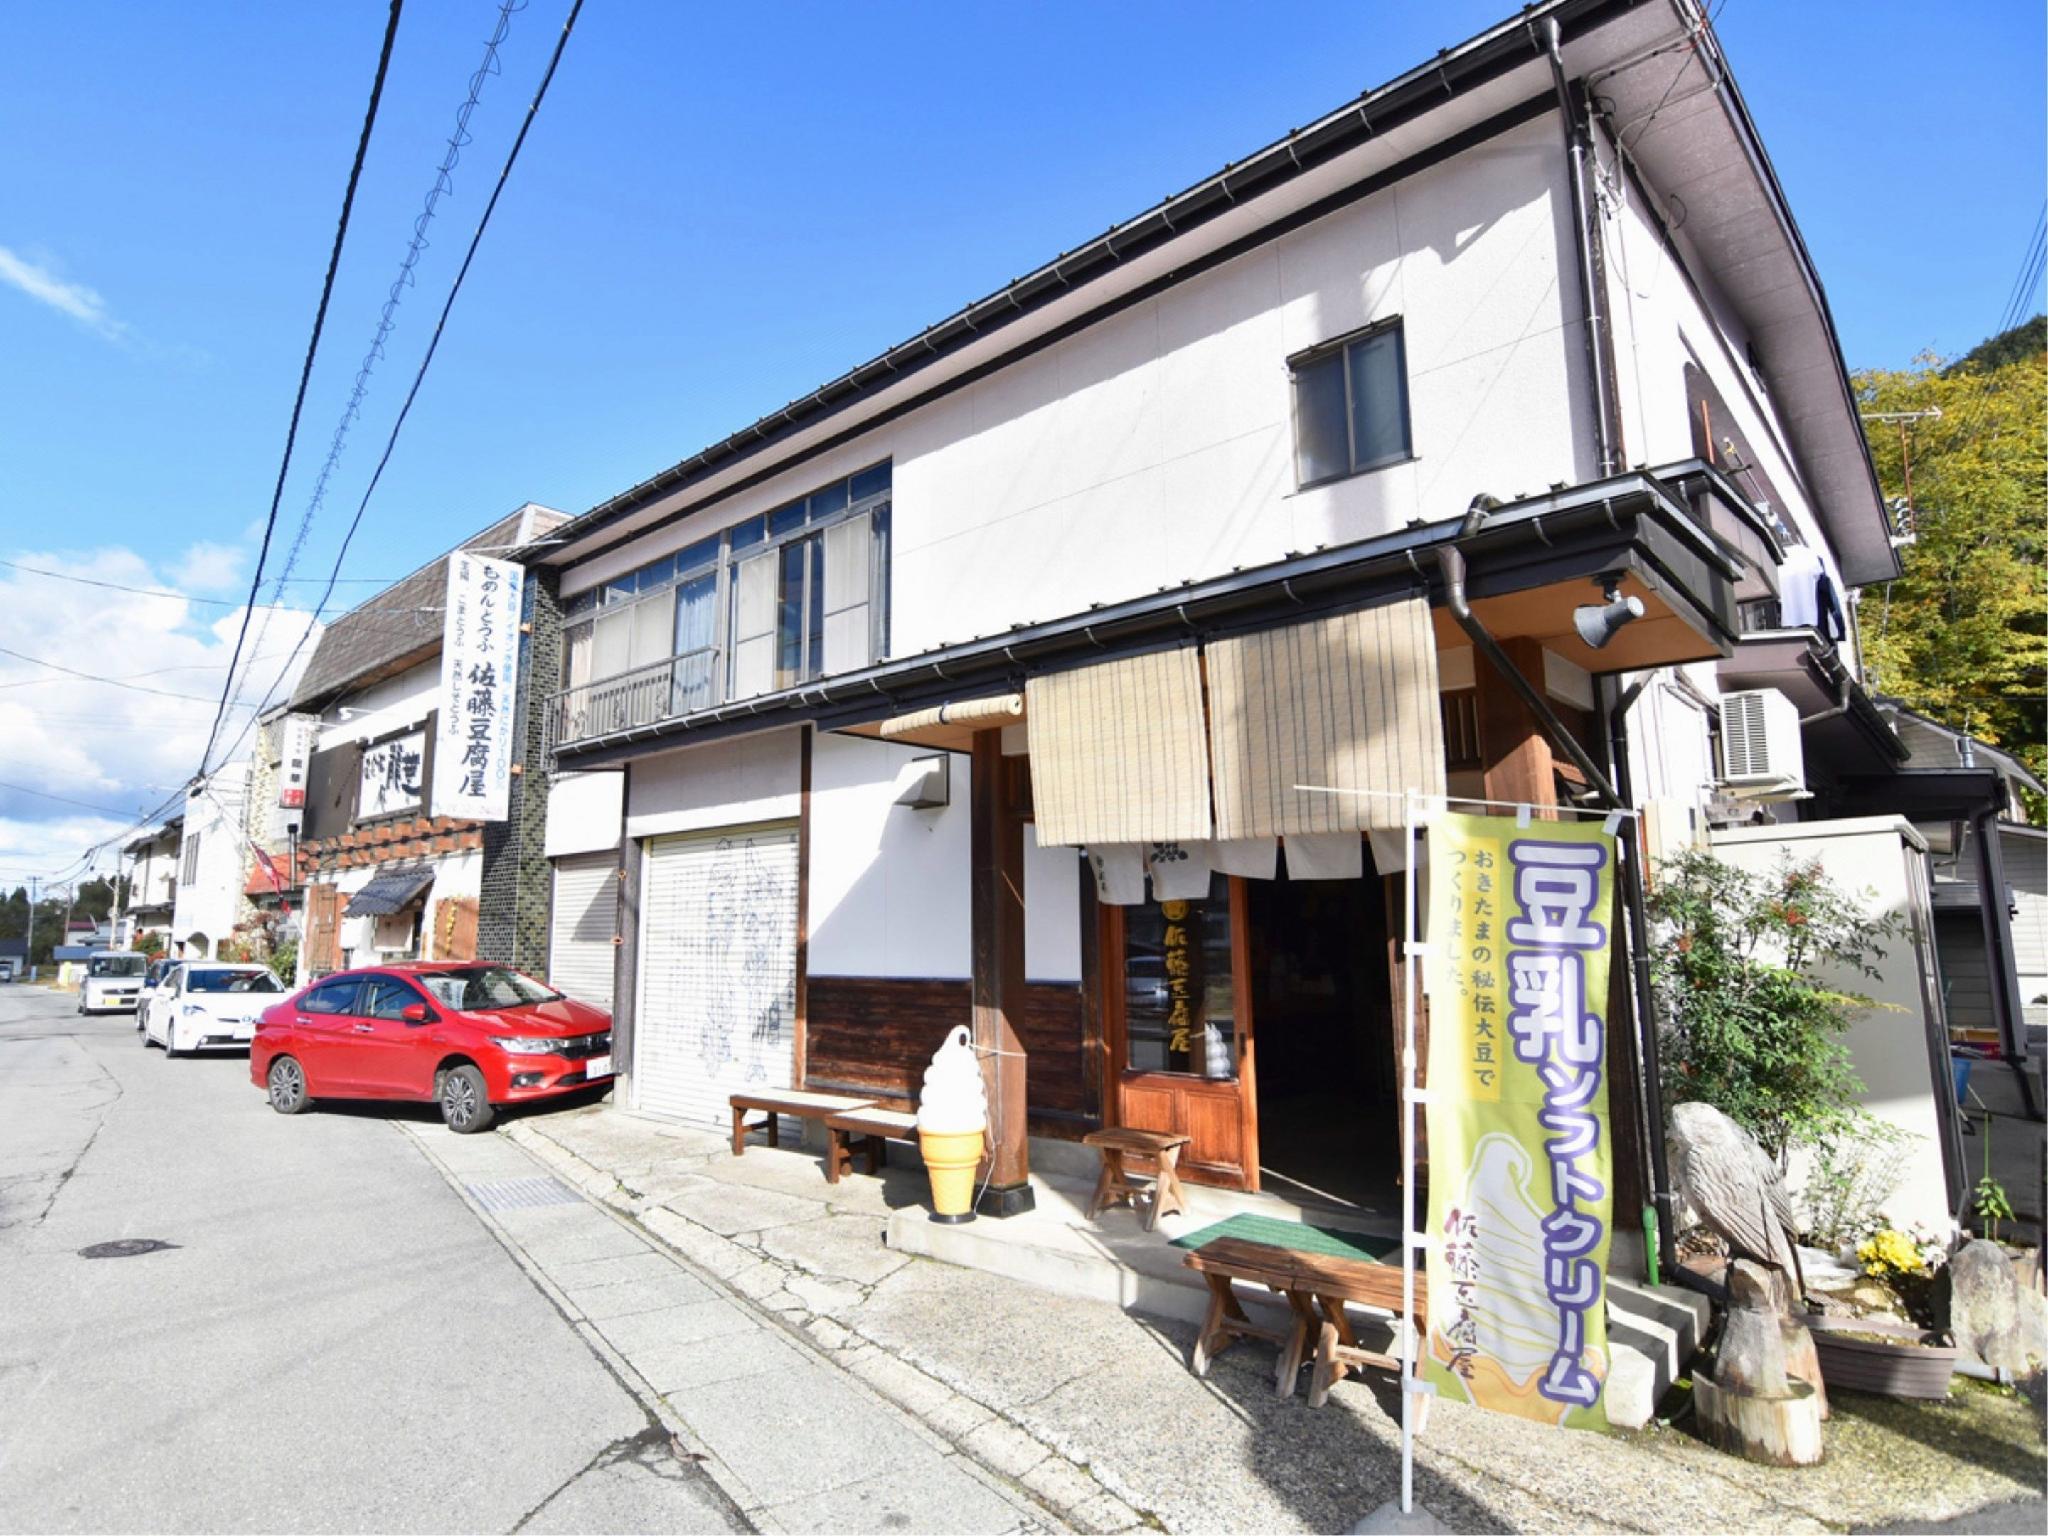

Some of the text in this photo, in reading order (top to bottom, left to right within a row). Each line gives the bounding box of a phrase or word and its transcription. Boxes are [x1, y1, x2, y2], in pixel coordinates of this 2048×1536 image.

[459, 565, 499, 798] もめんとうふ 佐藤豆腐屋
[1447, 850, 1468, 996] つくりました。
[1472, 850, 1496, 1087] おきたまの秘伝大豆で
[1506, 839, 1607, 1408] 豆乳ソフトクリーム
[1443, 1207, 1480, 1380] 佐藤豆腐屋
